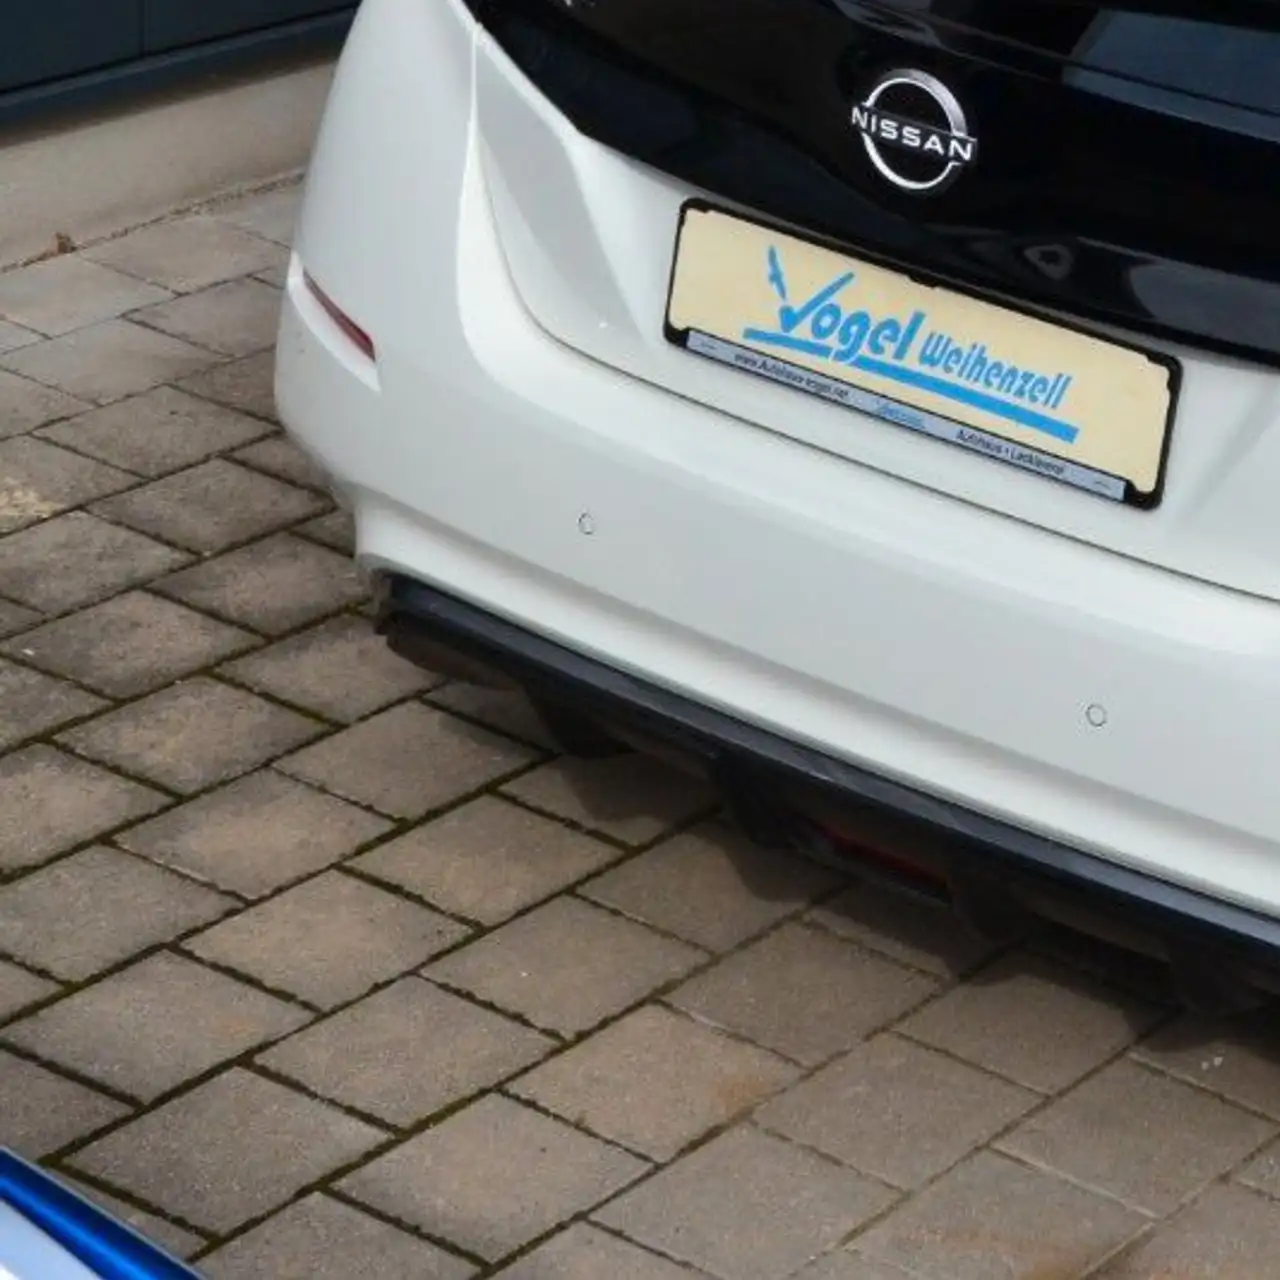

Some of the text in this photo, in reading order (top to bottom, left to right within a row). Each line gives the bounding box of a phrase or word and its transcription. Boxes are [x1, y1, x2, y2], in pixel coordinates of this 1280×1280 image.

[851, 104, 974, 162] NISSAN
[767, 244, 1072, 410] Vogel Weihenzell
